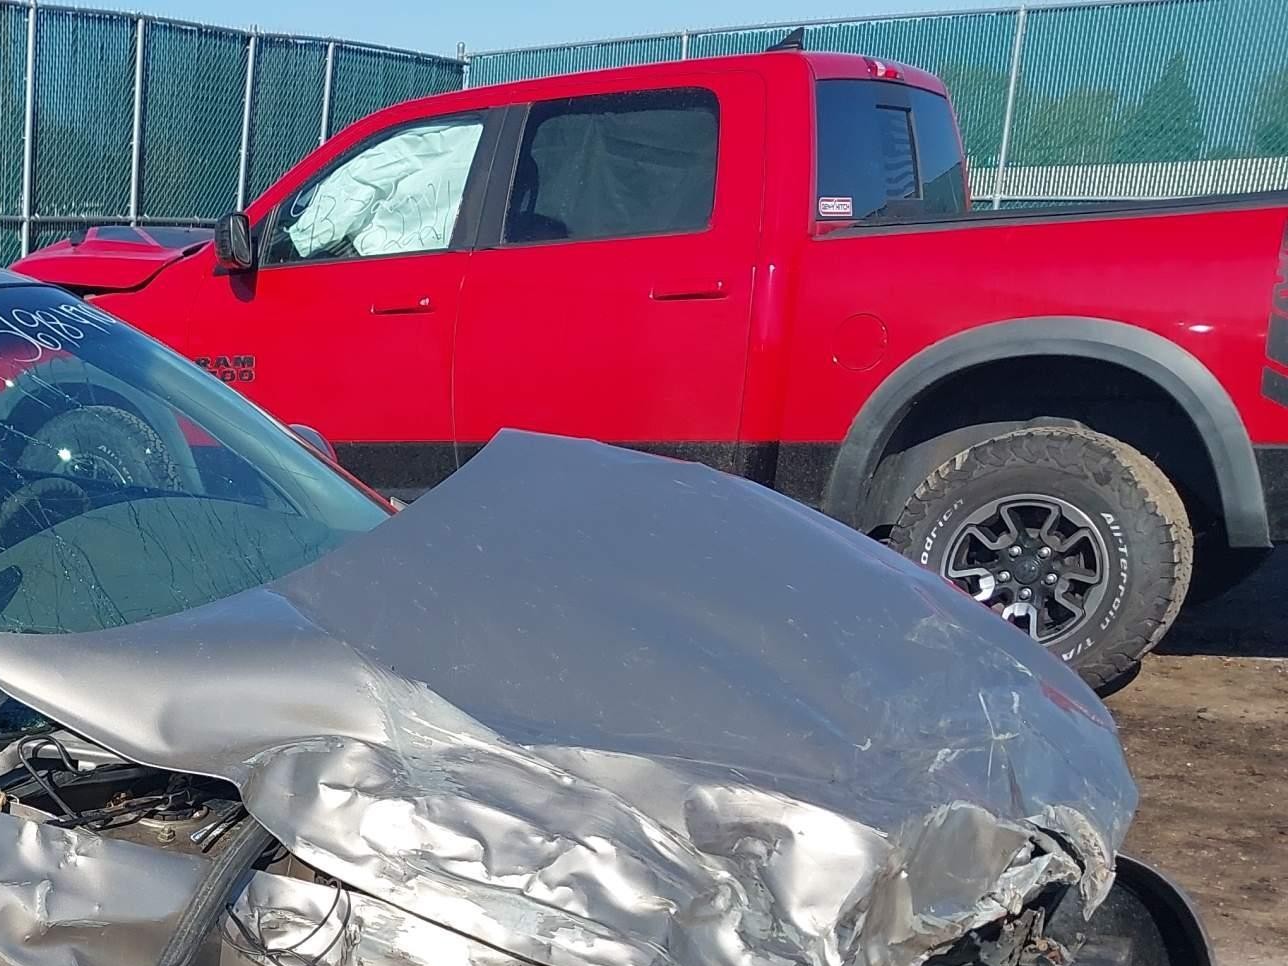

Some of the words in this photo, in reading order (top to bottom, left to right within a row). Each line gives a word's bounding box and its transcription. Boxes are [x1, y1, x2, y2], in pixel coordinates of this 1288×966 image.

[193, 355, 255, 369] RAM
[920, 497, 964, 565] odrich
[1099, 511, 1129, 631] All-Terrain
